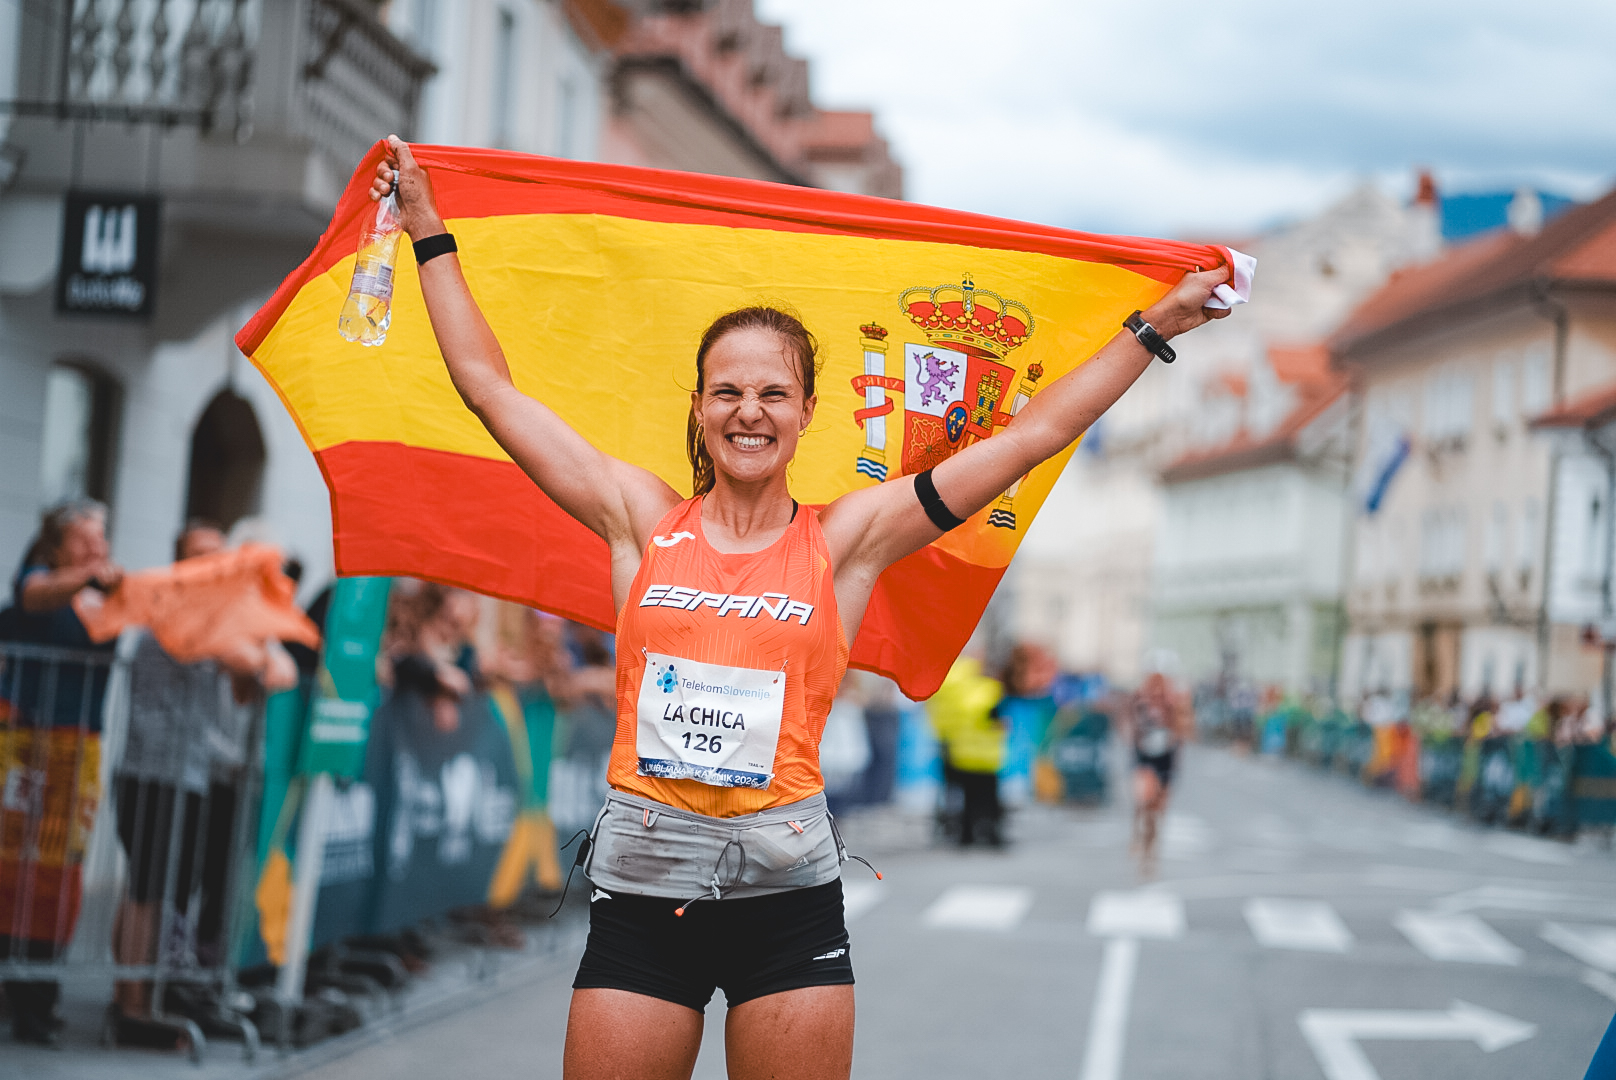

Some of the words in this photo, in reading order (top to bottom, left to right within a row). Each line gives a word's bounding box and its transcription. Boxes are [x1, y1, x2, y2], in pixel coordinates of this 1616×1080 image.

[639, 584, 814, 626] ESPAÑA
[682, 677, 771, 700] TelekomSlovenije
[663, 703, 684, 723] LA
[690, 707, 745, 730] CHICA
[682, 732, 722, 754] 126
[694, 769, 733, 783] KANIK
[734, 775, 758, 786] 2026
